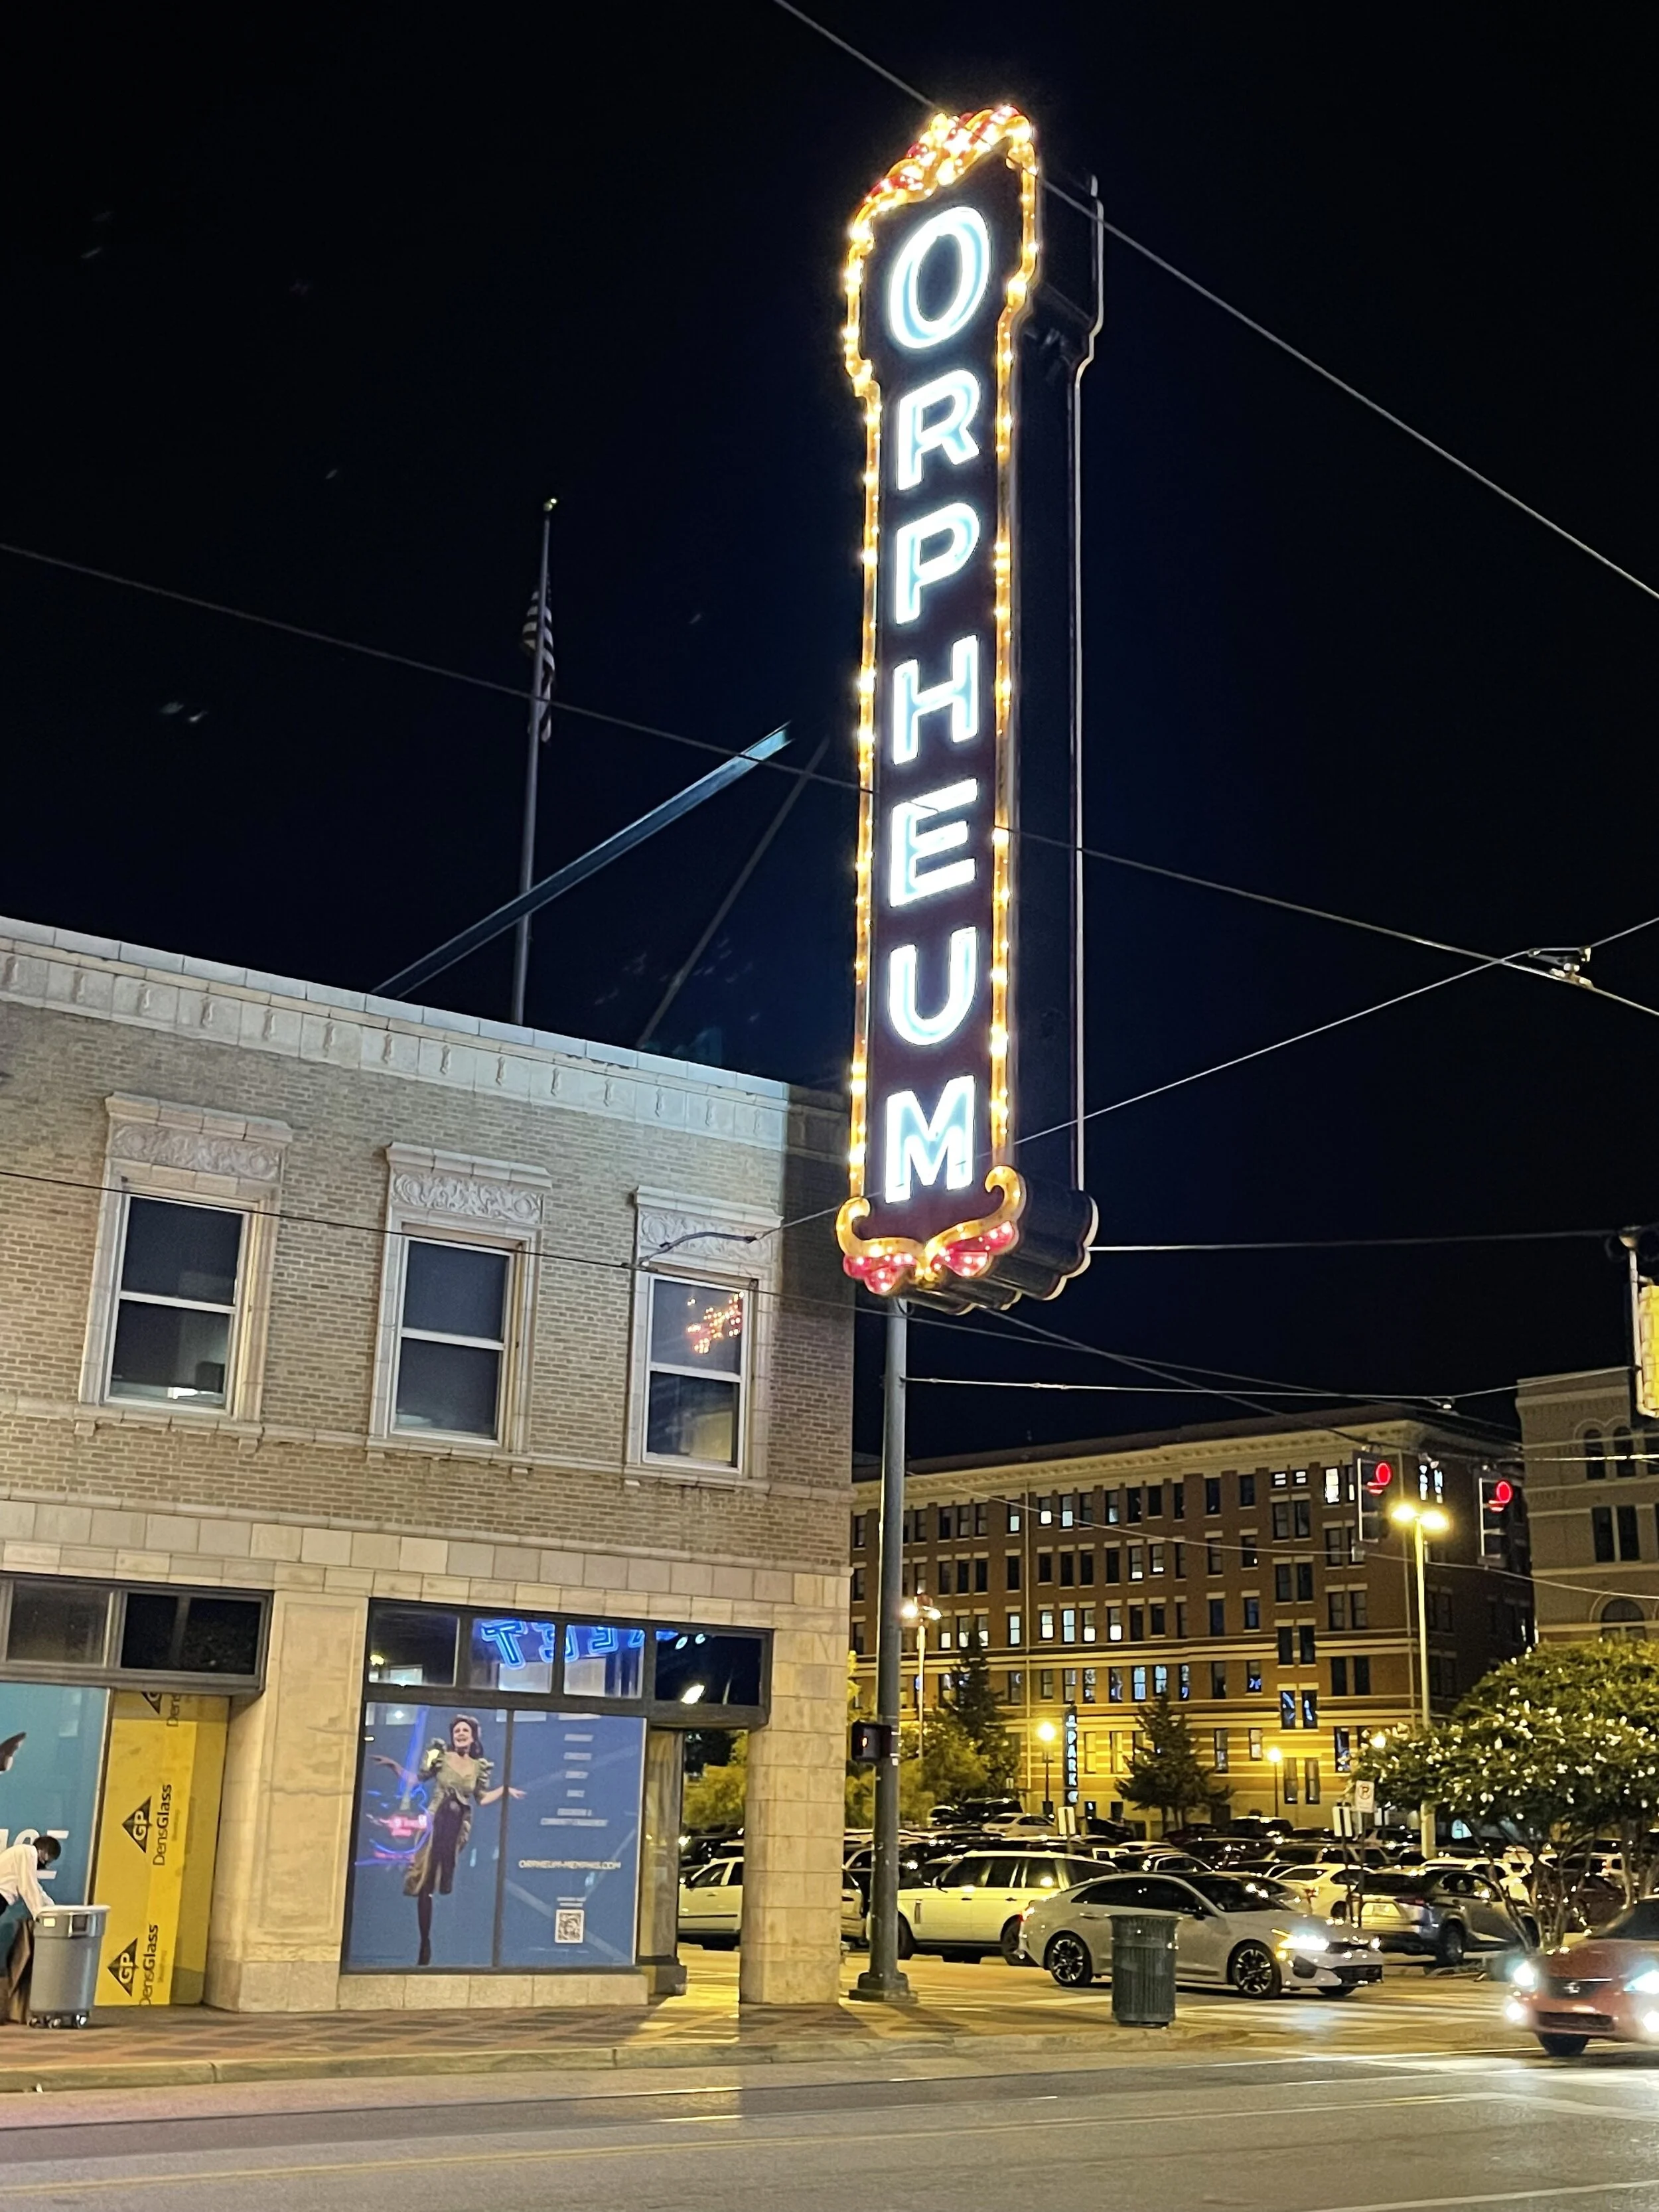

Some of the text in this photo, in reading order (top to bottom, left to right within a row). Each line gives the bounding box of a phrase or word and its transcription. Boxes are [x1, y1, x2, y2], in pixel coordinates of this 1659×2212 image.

[883, 204, 991, 1205] ORPHEUM
[1067, 1730, 1078, 1786] PARK
[133, 1810, 147, 1841] GP
[153, 1784, 173, 1866] DensGlass
[119, 1953, 133, 1984] GP
